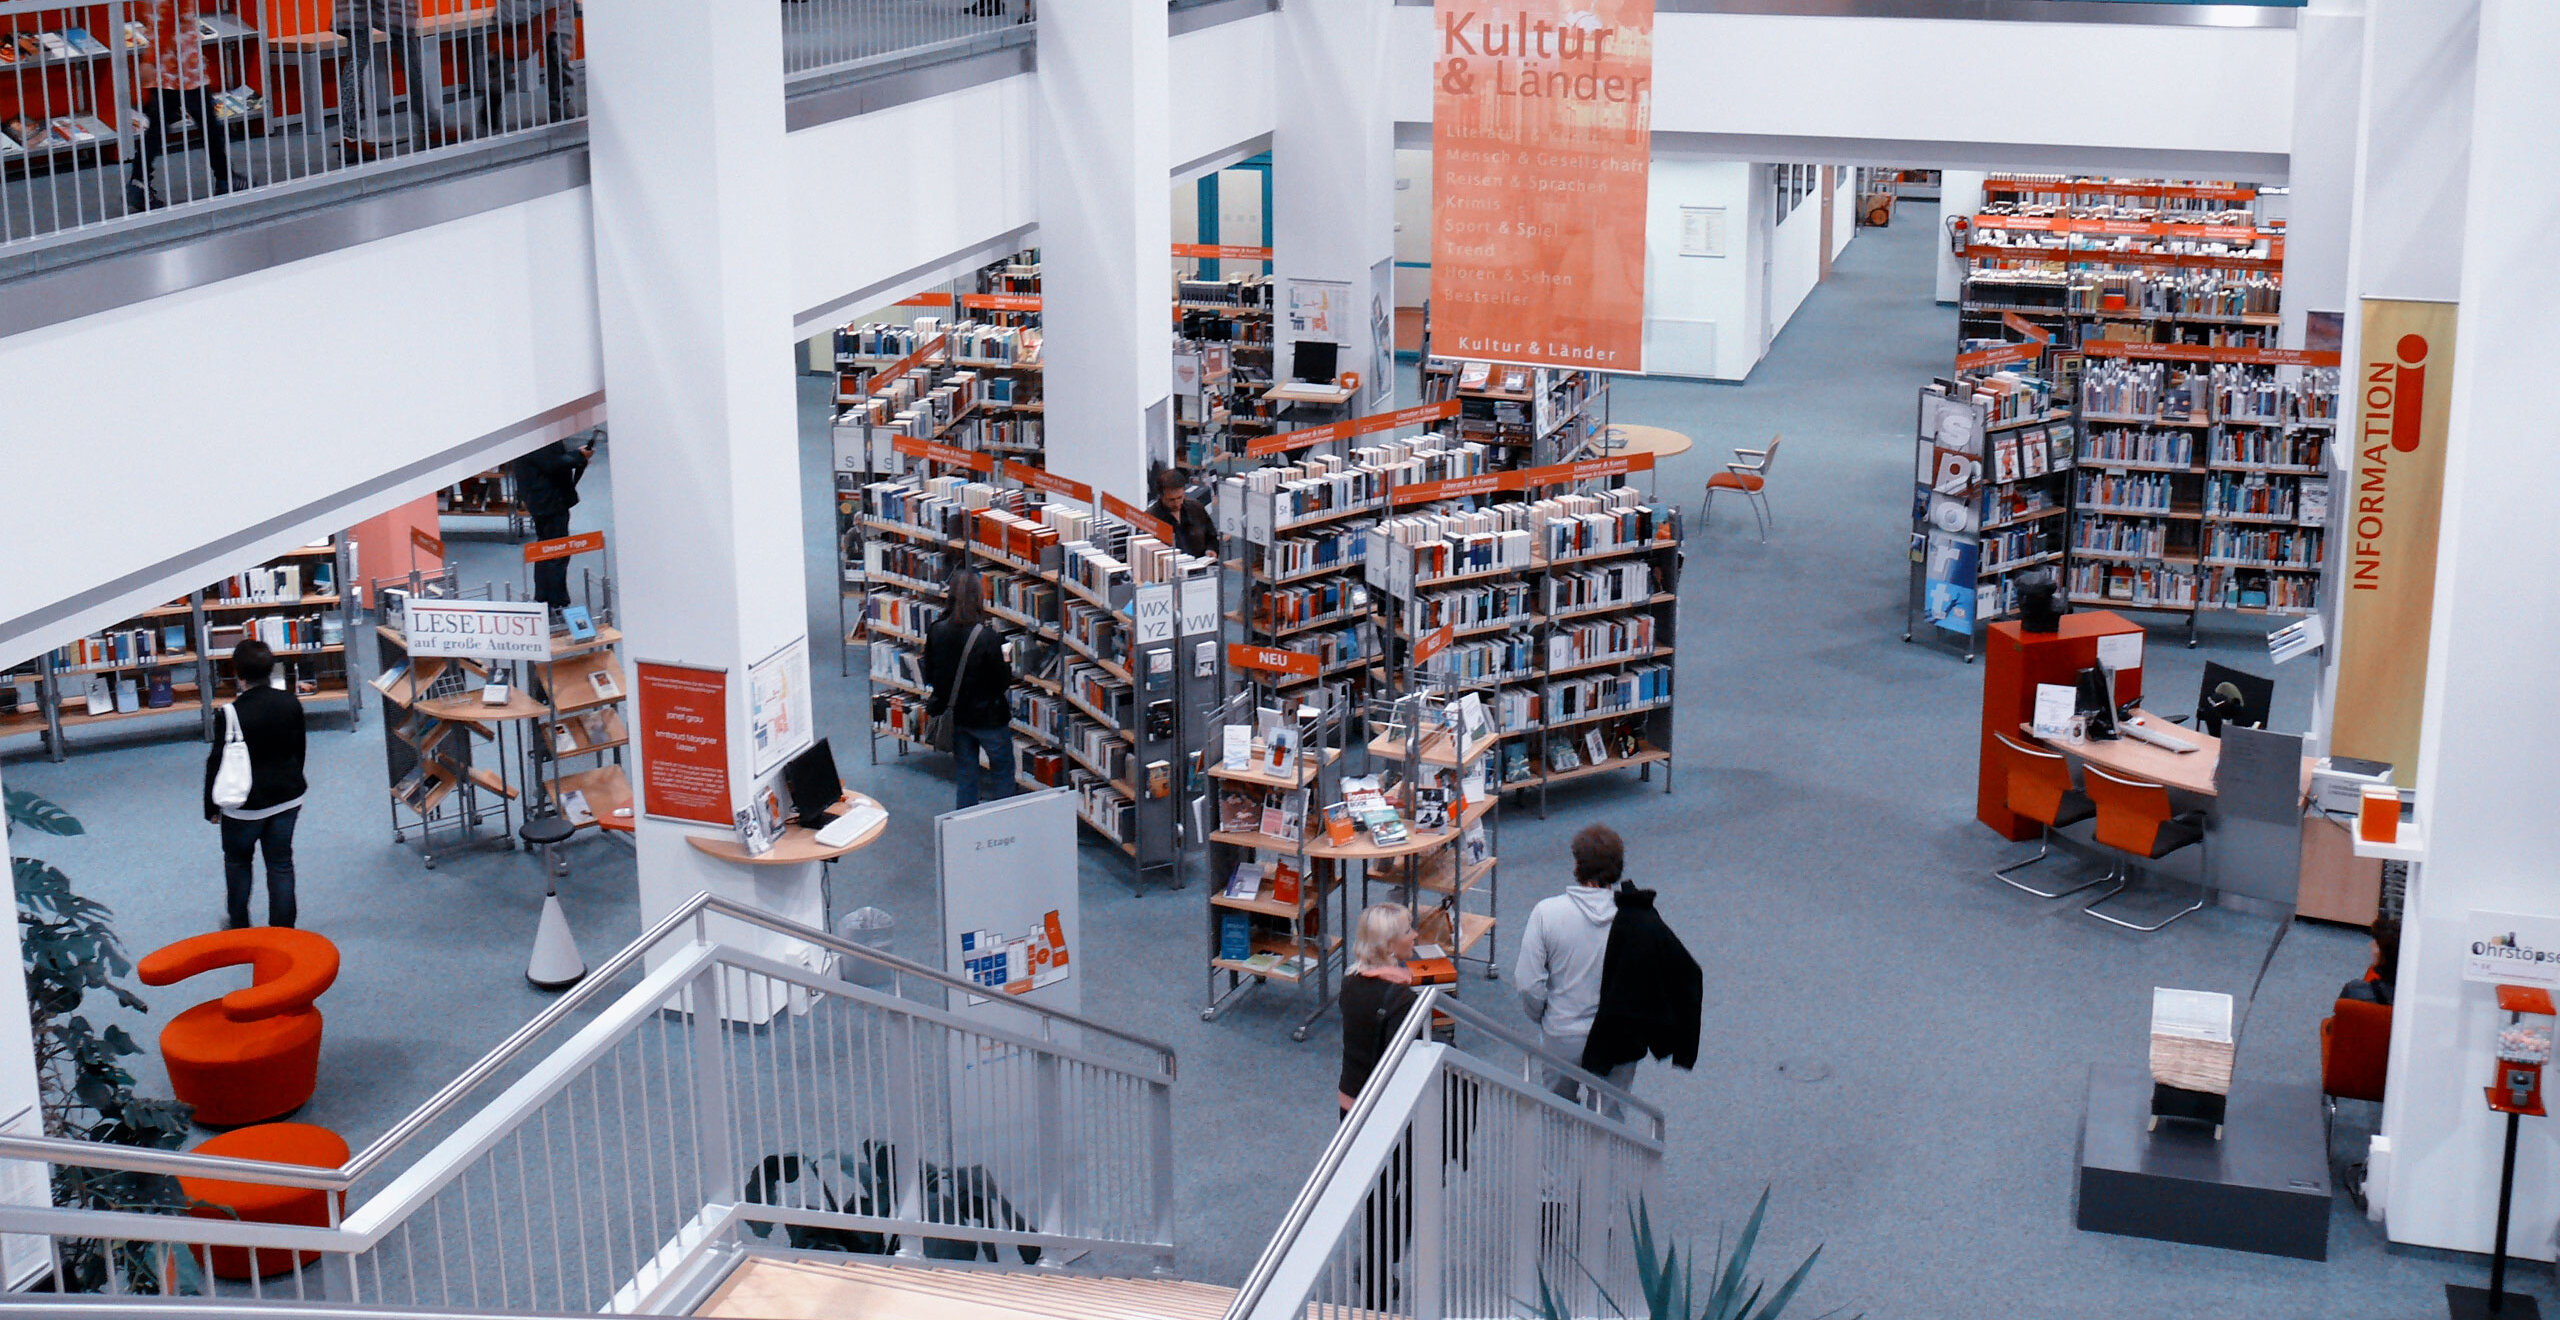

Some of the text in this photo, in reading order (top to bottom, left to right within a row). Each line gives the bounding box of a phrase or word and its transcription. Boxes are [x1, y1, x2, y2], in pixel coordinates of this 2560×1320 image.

[1445, 10, 1614, 62] Kultur
[1442, 57, 1648, 103] & Länder
[1446, 149, 1644, 174] Mensch & Gesellschaft
[1446, 172, 1609, 193] Reisen & Sprachen
[1446, 196, 1501, 209] Krimis
[1445, 219, 1558, 238] Sport & Spiel
[1445, 243, 1496, 257] Trend
[1503, 268, 1514, 282] &
[1522, 270, 1573, 286] Sehen
[1445, 288, 1529, 305] Bestseller
[1459, 336, 1616, 362] Kultur & Länder
[845, 456, 855, 468] S
[2353, 362, 2395, 590] INFORMATION
[542, 540, 588, 553] Unser Tipp
[1140, 600, 1170, 618] WX
[413, 612, 542, 636] LESELUST
[1144, 621, 1167, 639] YZ
[1187, 613, 1215, 631] VW
[414, 636, 543, 652] auf große Autoren
[1258, 651, 1289, 667] NEU
[987, 835, 1016, 848] Etage
